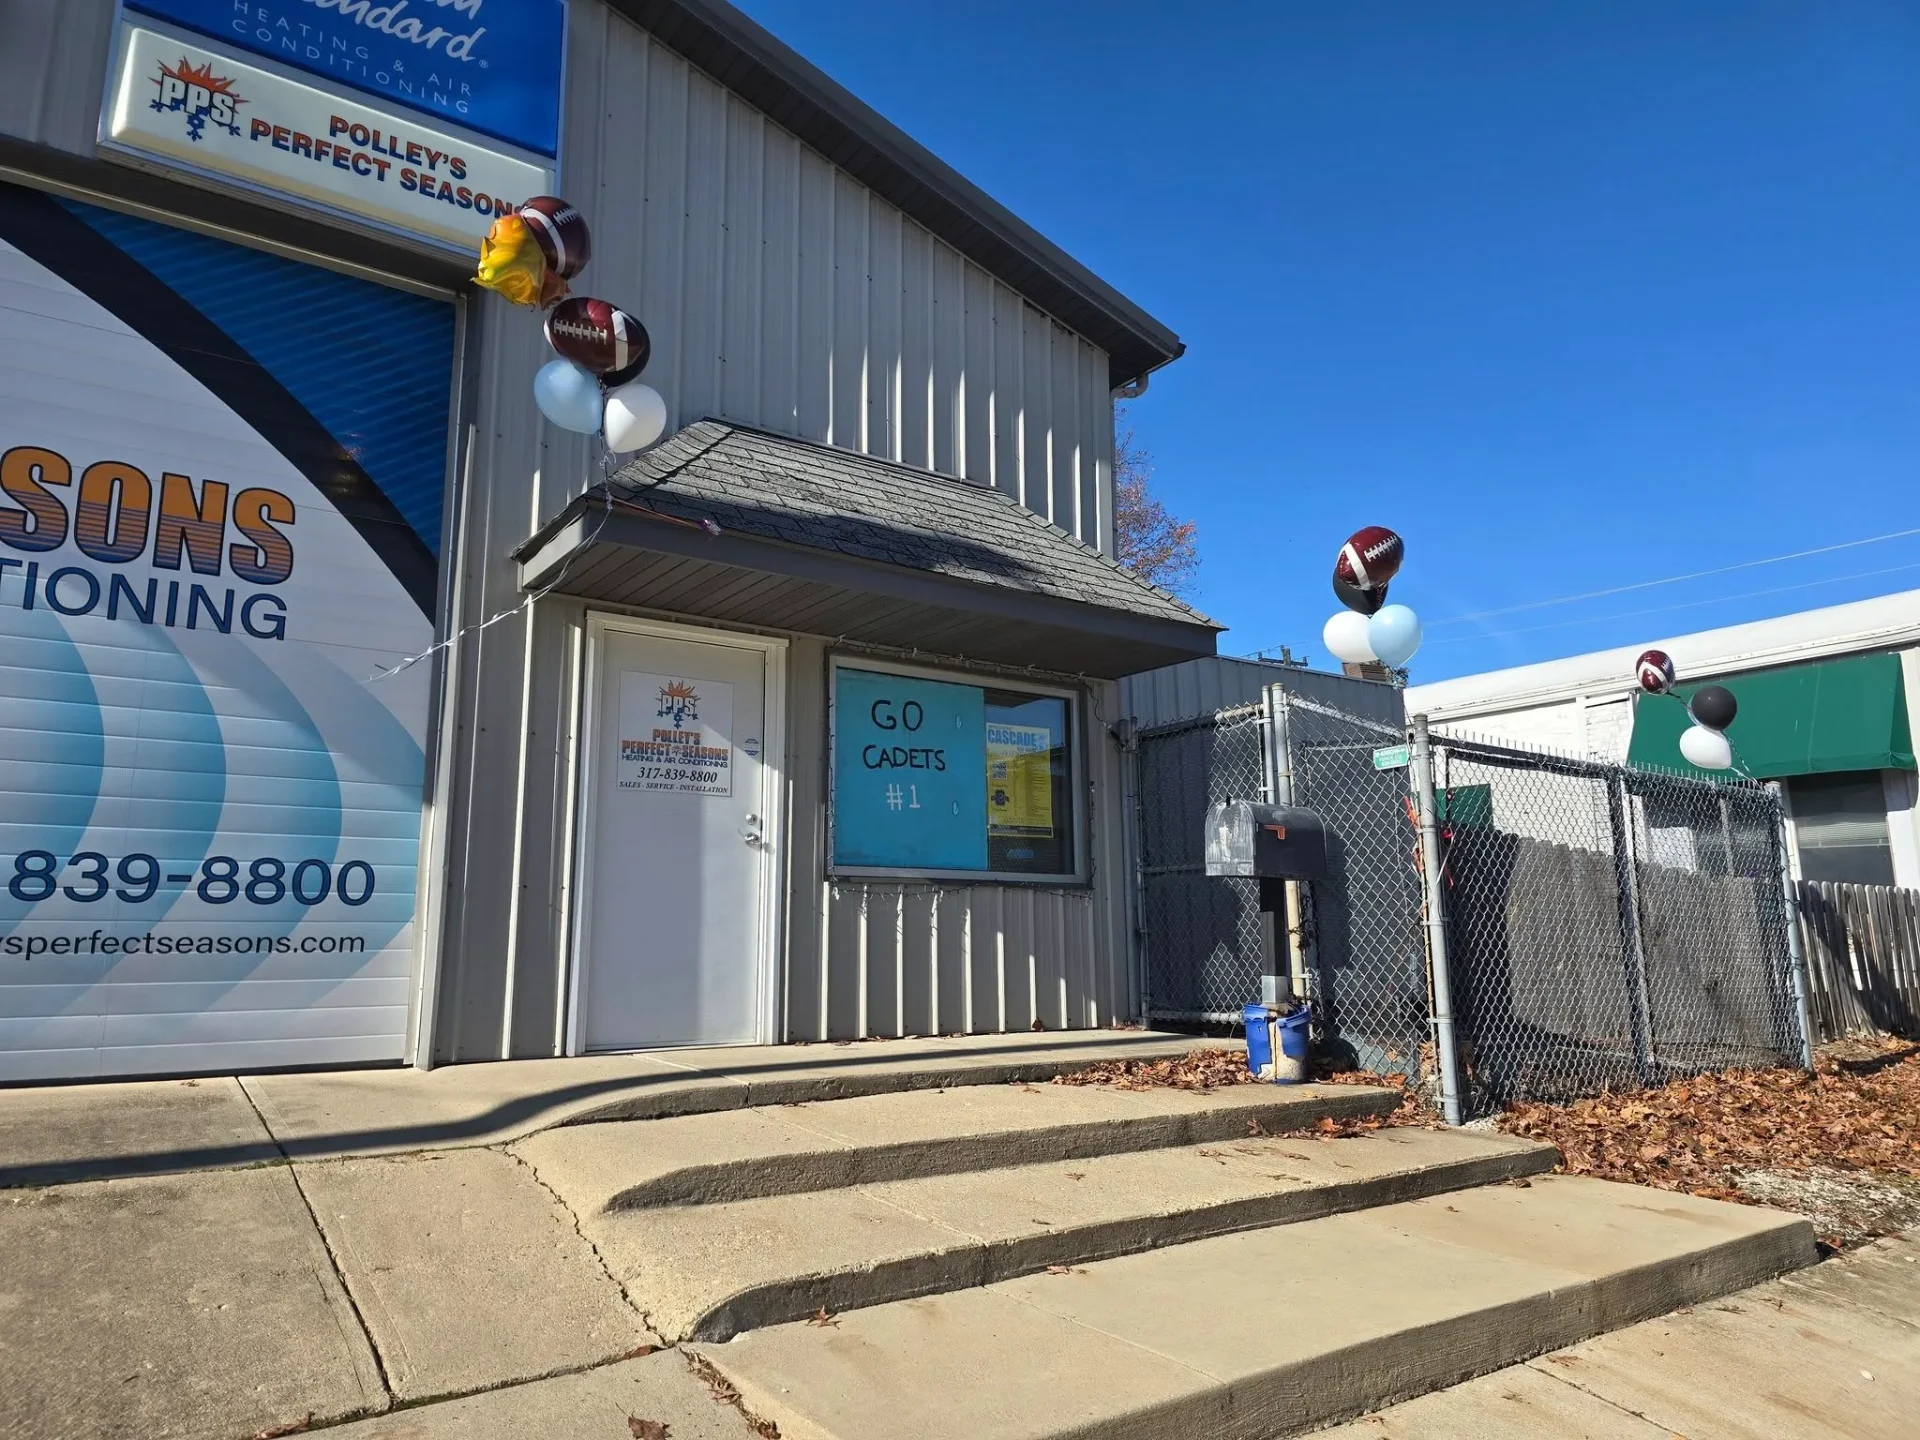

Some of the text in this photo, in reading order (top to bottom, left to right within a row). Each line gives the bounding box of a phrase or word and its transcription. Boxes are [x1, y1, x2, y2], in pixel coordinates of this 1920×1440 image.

[309, 0, 487, 61] ndard
[234, 0, 471, 96] HEATING & AIR
[232, 19, 468, 113] CONDITIONING
[159, 73, 235, 127] PPS
[329, 115, 467, 180] POLLEY'S
[250, 118, 521, 218] PERFECT SEASON
[0, 445, 295, 585] SONS
[660, 691, 697, 717] PPS
[871, 699, 923, 731] GO
[622, 740, 671, 756] PERFECT
[681, 744, 728, 761] SEASONS
[652, 729, 701, 745] POLLEY'S
[988, 729, 1036, 746] CASCADE
[622, 754, 654, 763] HEATING
[679, 757, 728, 768] CONDITIONING
[863, 745, 945, 771] CADETS
[637, 767, 718, 783] 317-839-8800
[646, 782, 675, 790] SERVICE
[680, 784, 728, 793] INSTALLATION
[886, 784, 920, 810] #1
[8, 850, 375, 906] 839-8800
[0, 930, 365, 960] sperfectseasons.com
